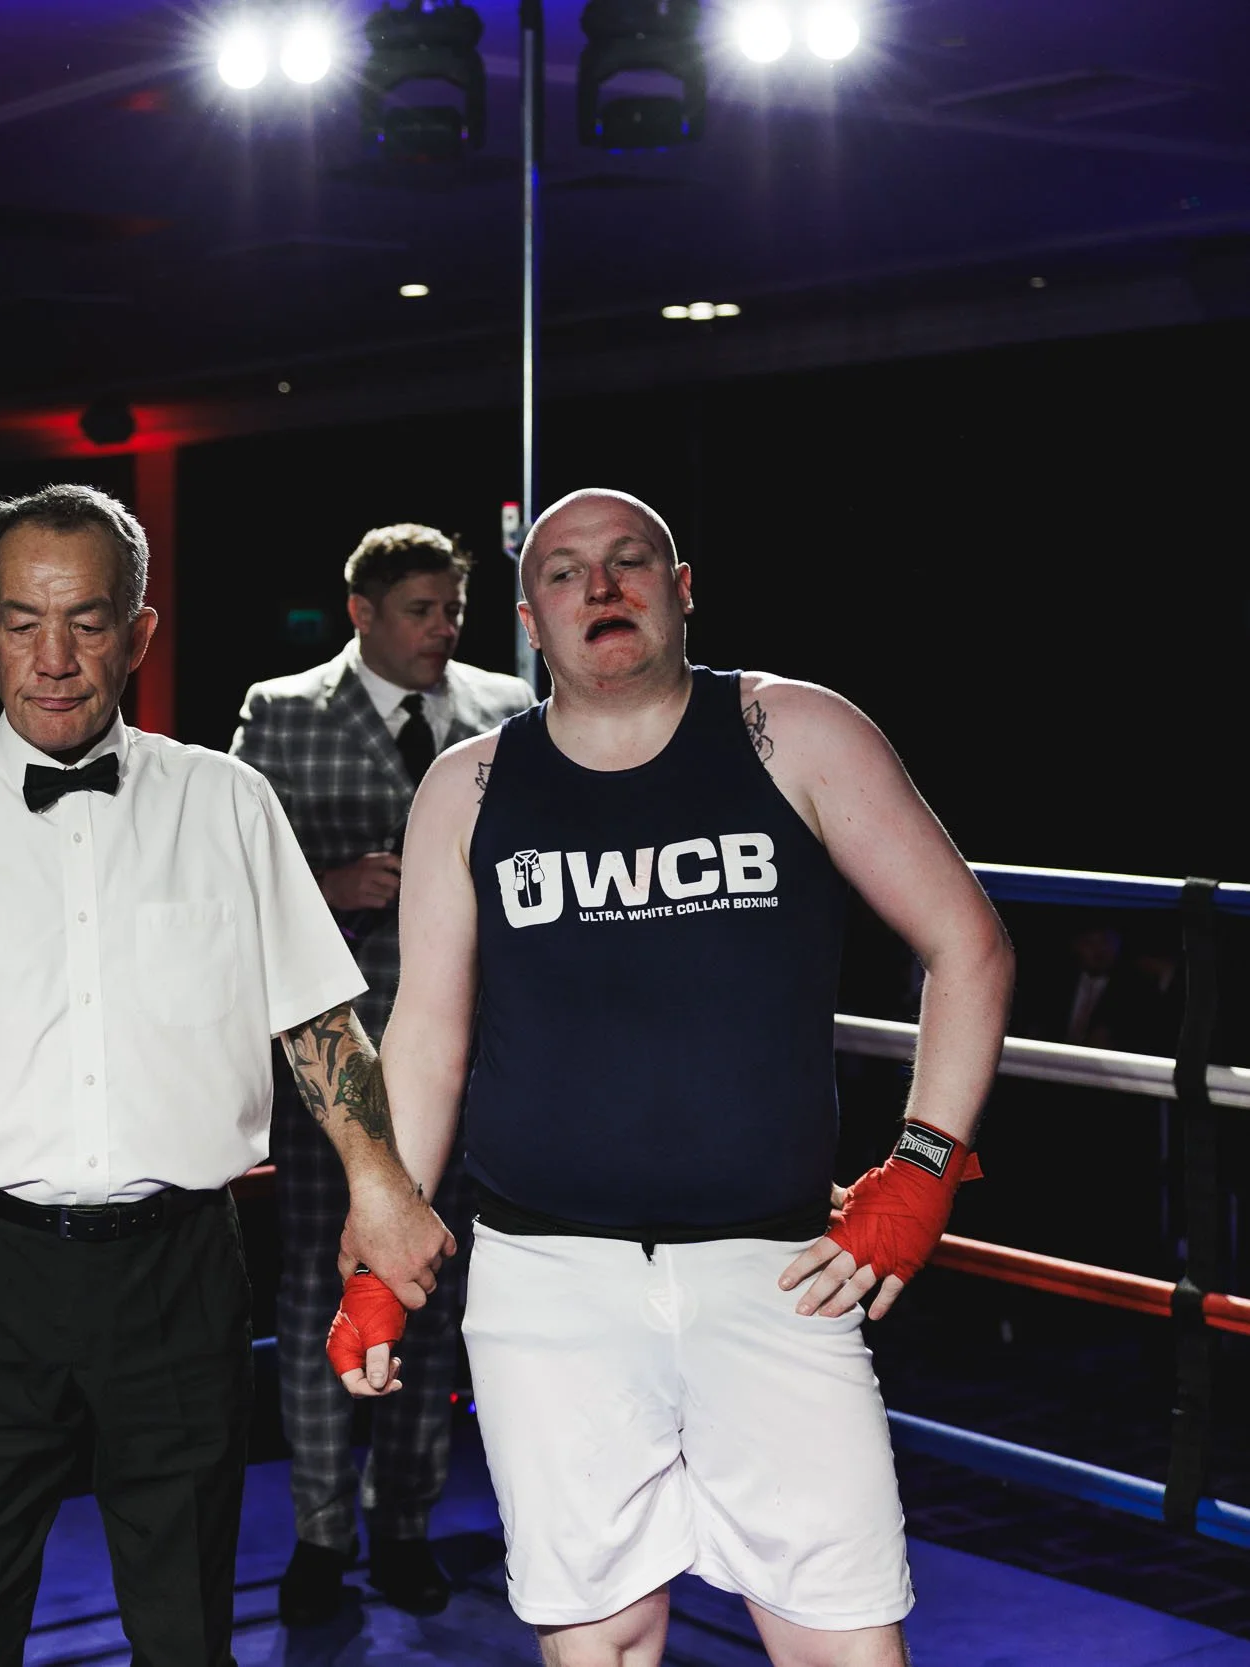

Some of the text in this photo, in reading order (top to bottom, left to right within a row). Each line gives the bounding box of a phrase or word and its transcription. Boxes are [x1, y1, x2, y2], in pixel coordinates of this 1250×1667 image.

[495, 832, 778, 929] UWCB
[579, 896, 779, 922] ULTRA WHITE COLLAR BOXING
[899, 1131, 948, 1169] LONSDALE
